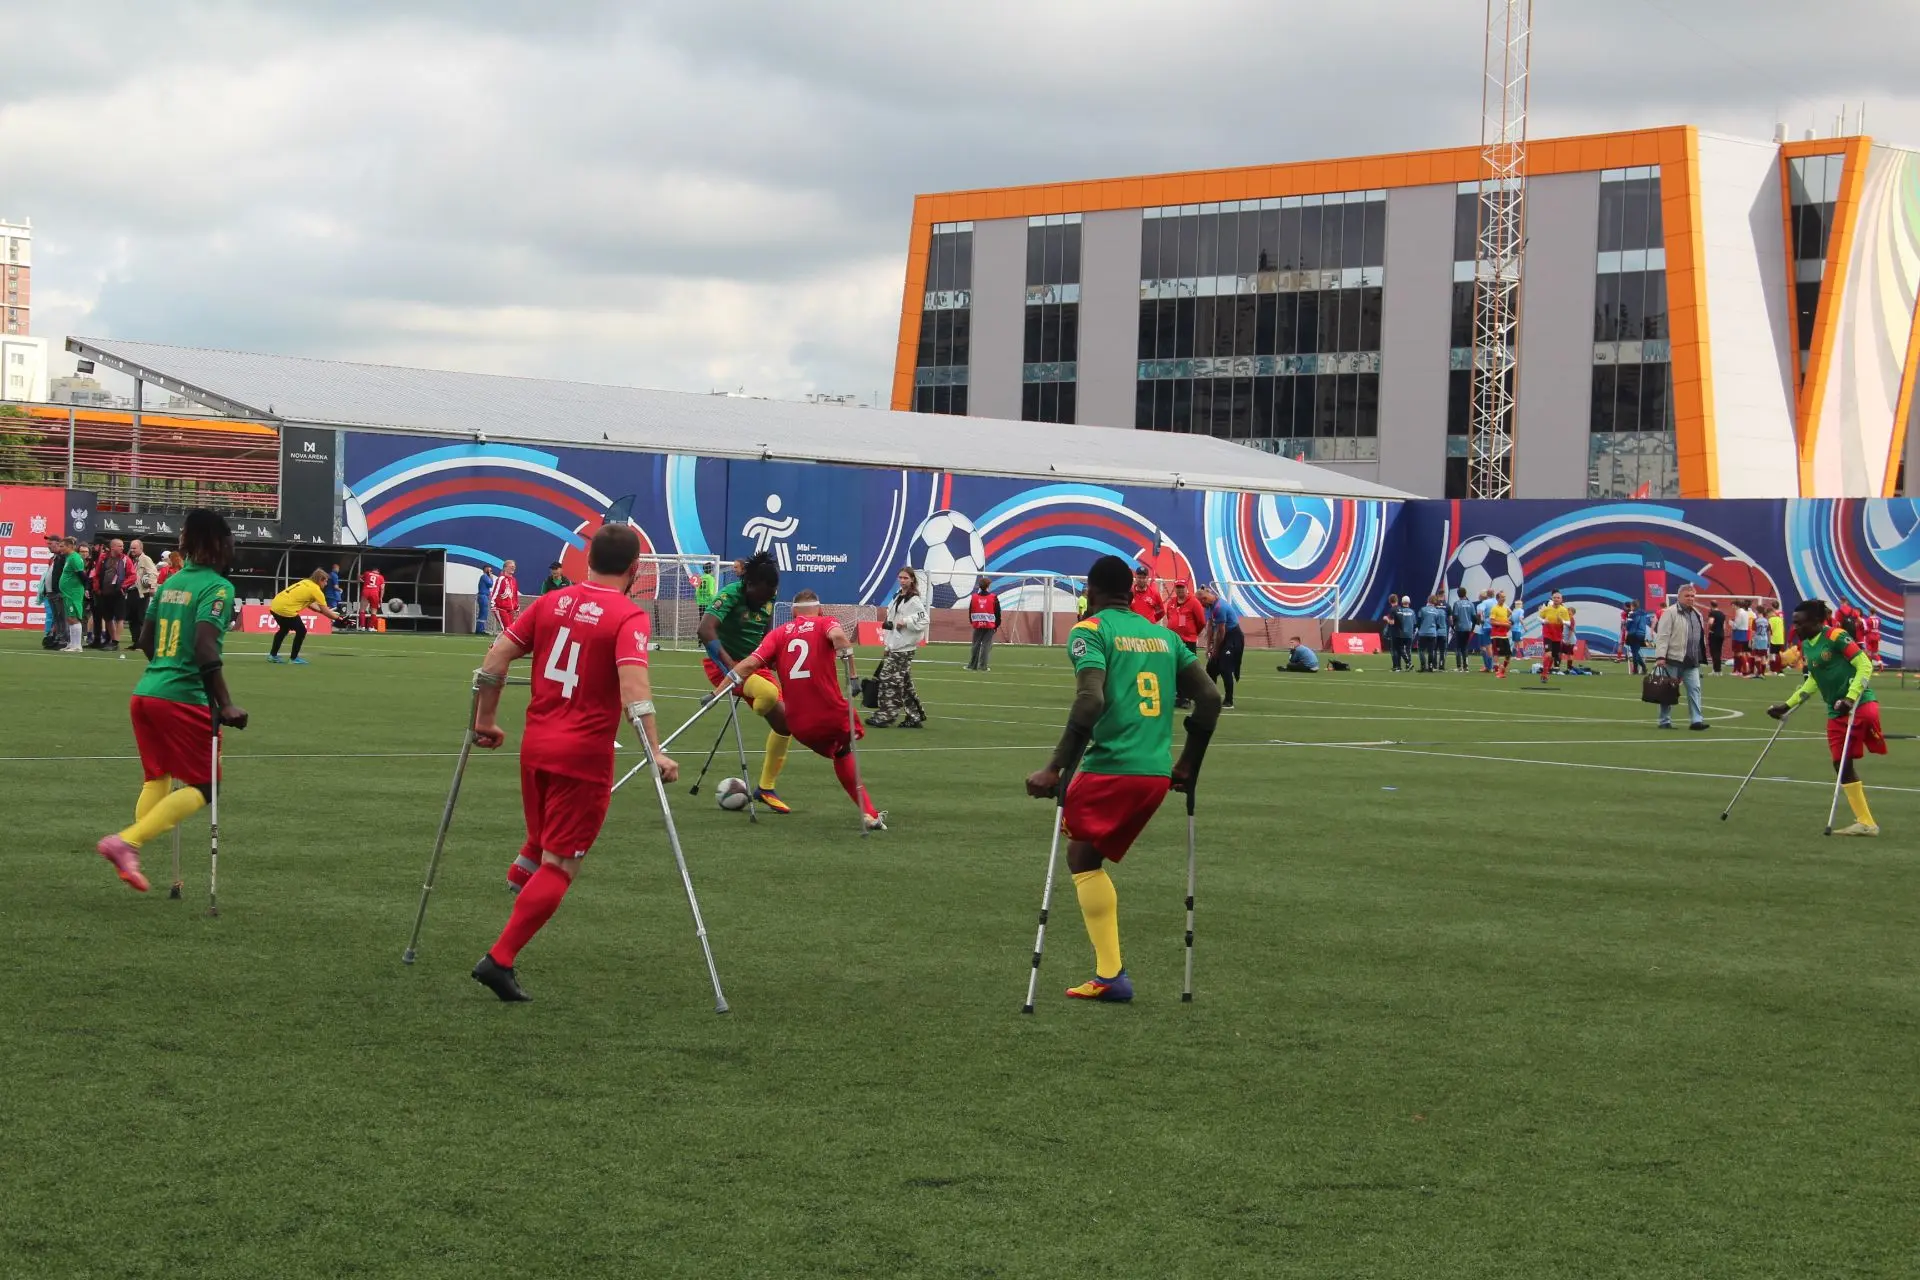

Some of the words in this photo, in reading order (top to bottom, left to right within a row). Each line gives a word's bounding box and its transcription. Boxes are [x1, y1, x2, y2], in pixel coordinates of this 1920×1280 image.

[796, 543, 810, 551] МЫ
[796, 553, 848, 563] СПОРТИВНЫЙ
[795, 563, 837, 573] ПЕТЕРБУРГ
[369, 575, 377, 586] 9
[692, 576, 699, 585] 2
[259, 614, 318, 629] FOET
[1114, 636, 1169, 653] CAMEROUN
[544, 626, 581, 699] 4
[788, 638, 810, 680] 2
[1137, 671, 1160, 717] 9
